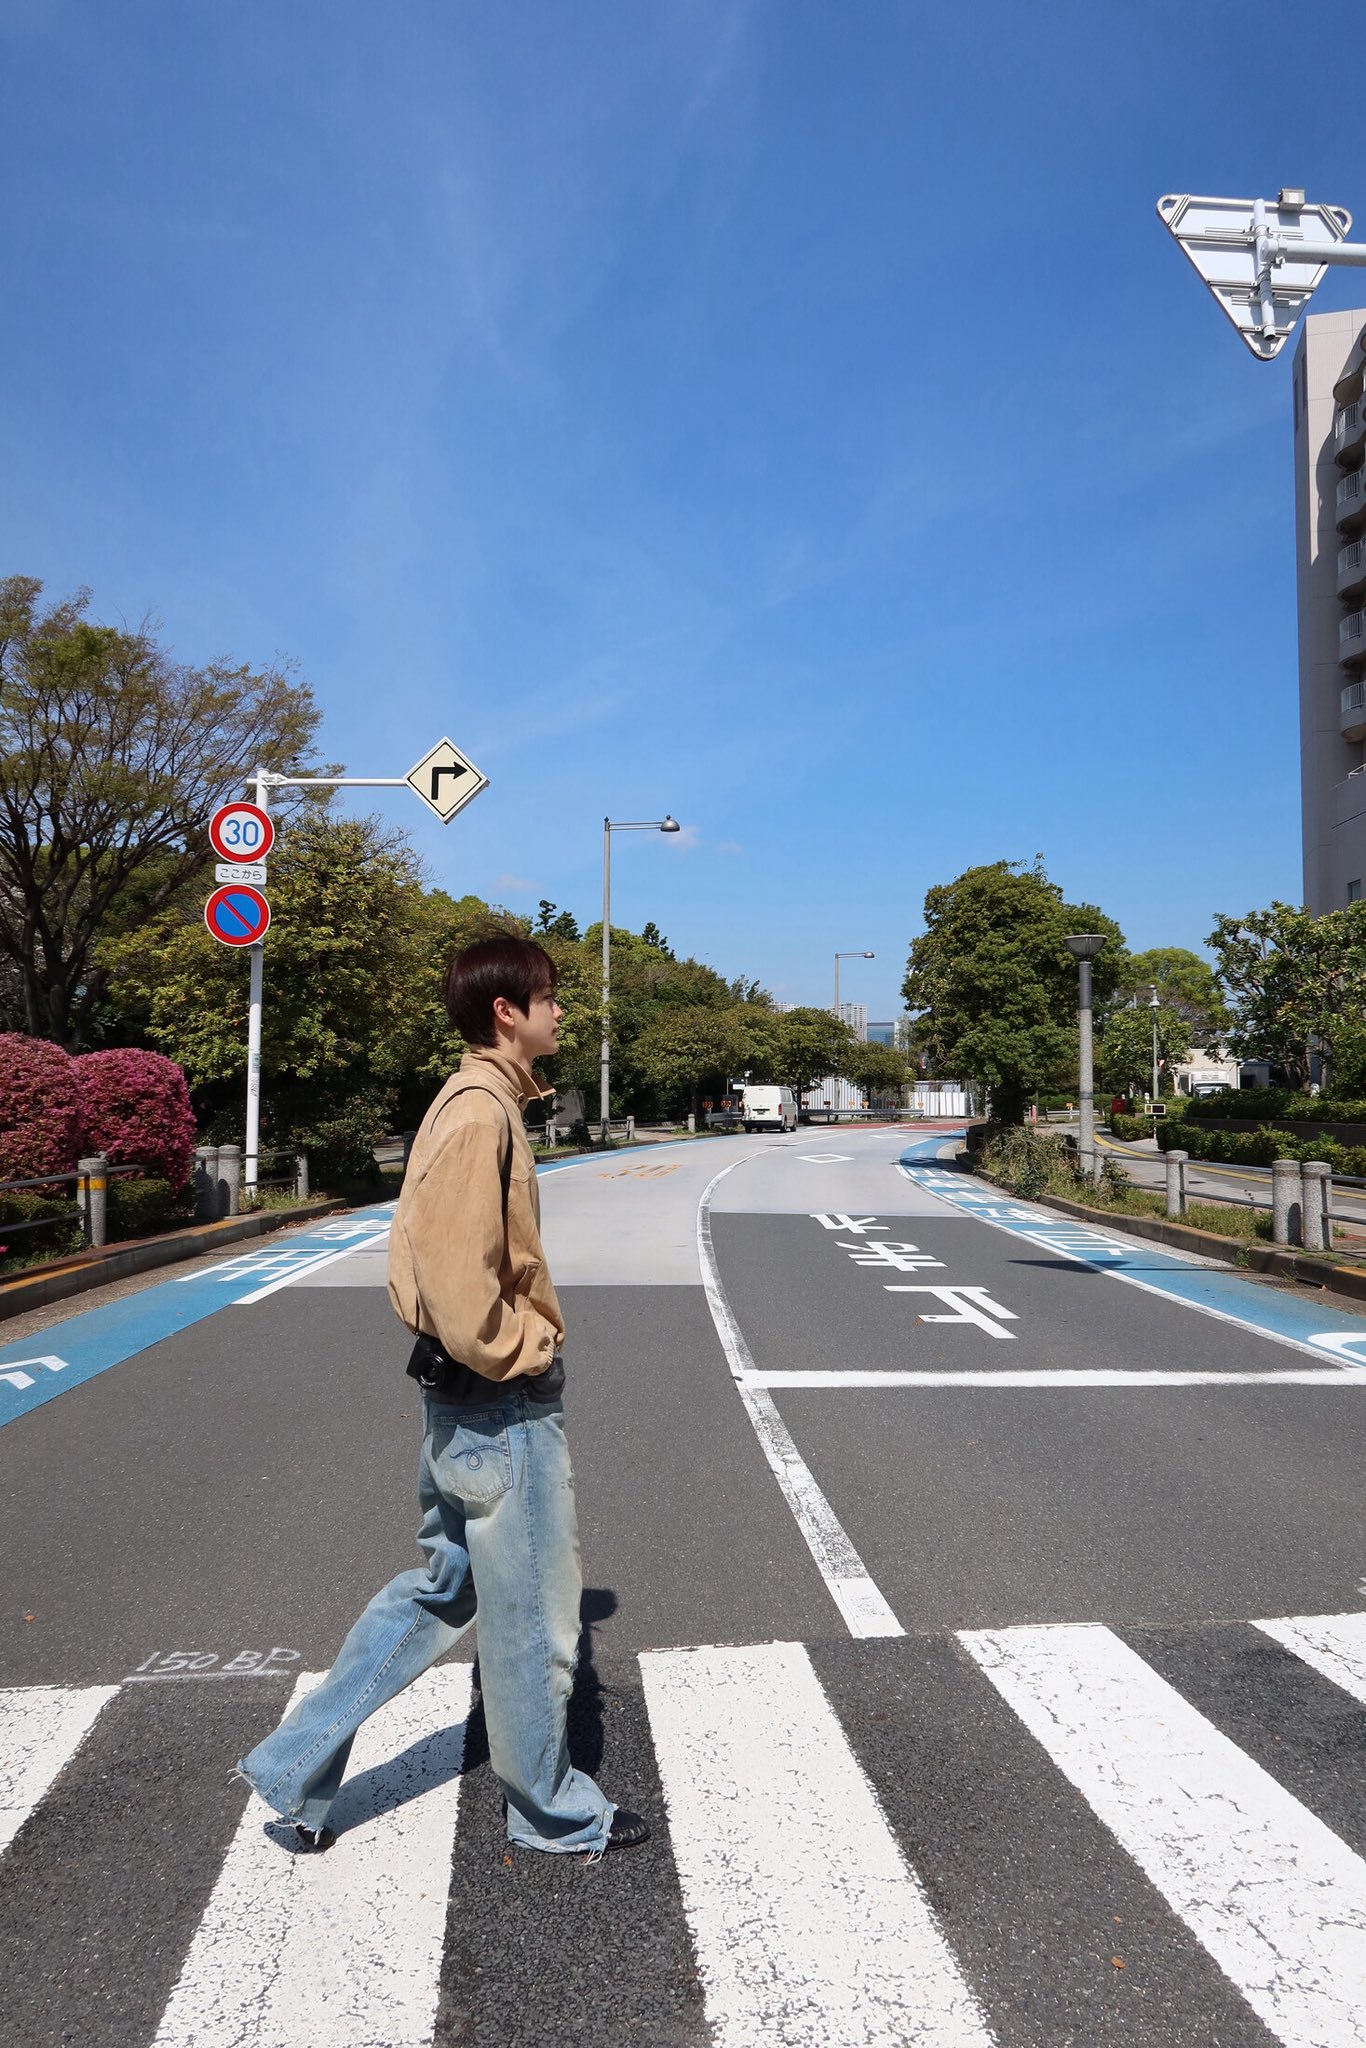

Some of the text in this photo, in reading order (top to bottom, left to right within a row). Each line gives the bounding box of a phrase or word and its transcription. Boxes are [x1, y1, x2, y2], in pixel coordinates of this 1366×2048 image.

[225, 819, 259, 847] 30
[220, 868, 262, 881] ここから
[809, 1213, 1021, 1339] 止まれ
[136, 1647, 301, 1675] 150 BP
